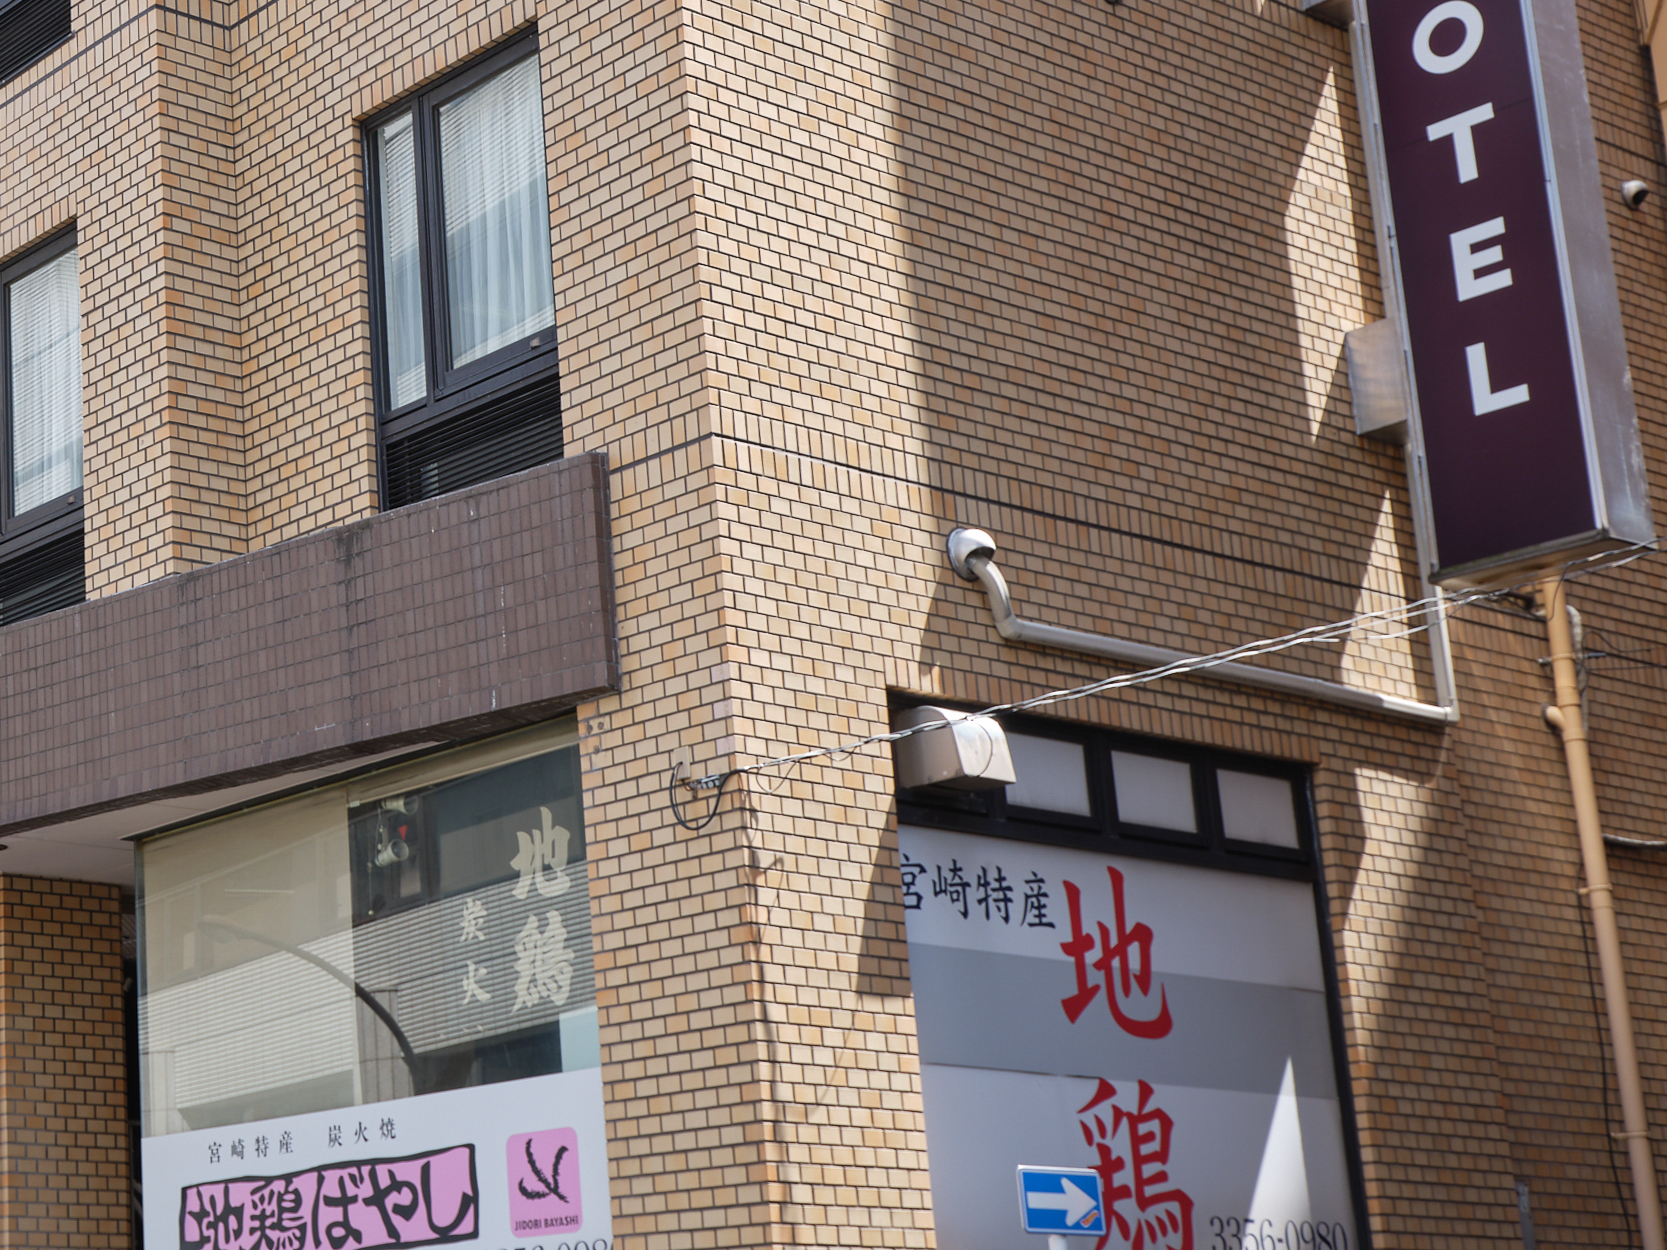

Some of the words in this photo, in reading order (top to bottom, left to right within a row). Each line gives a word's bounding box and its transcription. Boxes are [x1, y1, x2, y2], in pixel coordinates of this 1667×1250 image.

[900, 853, 1056, 929] 宮崎特産
[1060, 865, 1195, 1250] 地鶏
[208, 1130, 294, 1164] 宮崎特産
[328, 1117, 397, 1148] 炭火焼
[186, 1158, 474, 1250] 地鶏ばやし
[515, 1219, 542, 1231] JIDORI
[544, 1215, 579, 1228] BAYASHI
